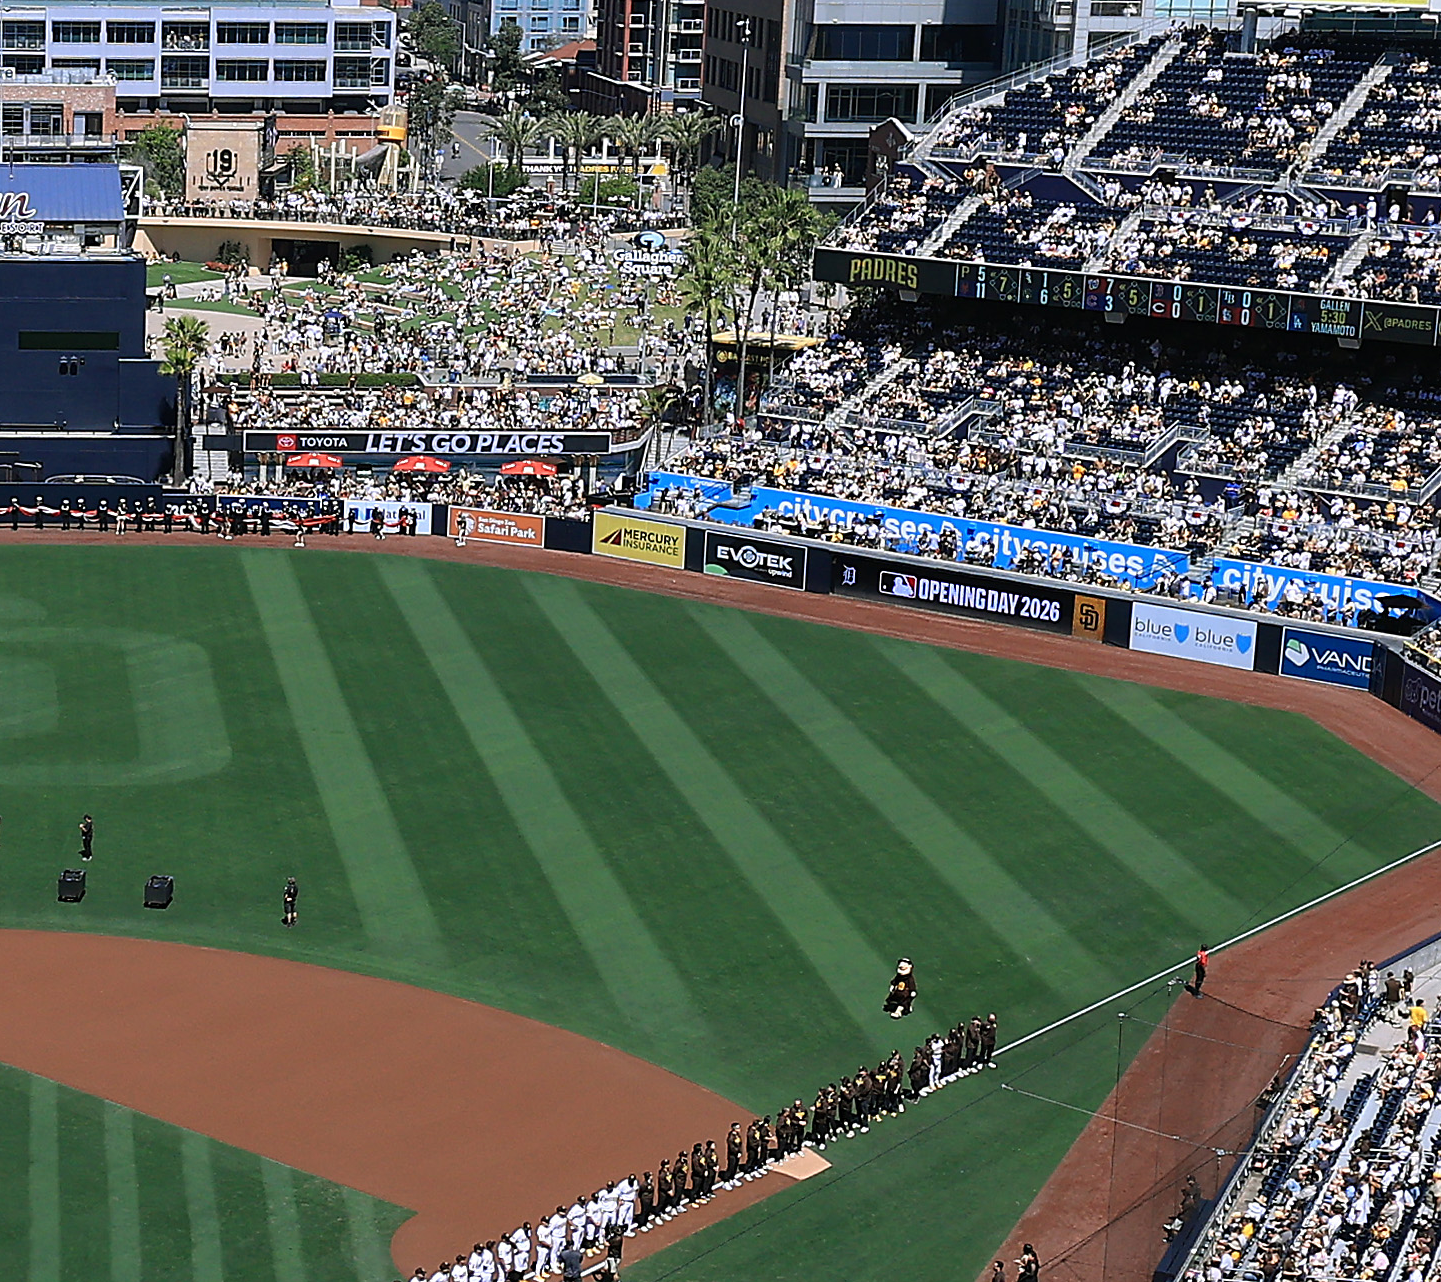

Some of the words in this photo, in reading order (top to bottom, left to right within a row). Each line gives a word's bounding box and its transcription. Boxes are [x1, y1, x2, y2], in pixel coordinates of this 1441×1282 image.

[212, 149, 233, 173] 19
[521, 165, 551, 173] THANK
[614, 248, 683, 267] Gallagher
[623, 263, 672, 277] Square
[849, 258, 918, 289] PADRES
[978, 266, 986, 281] 5
[976, 282, 986, 298] 11
[999, 276, 1008, 292] 7
[1063, 282, 1072, 298] 5
[1106, 279, 1115, 293] 7
[1040, 289, 1049, 304] 6
[1128, 289, 1138, 305] 5
[1173, 285, 1182, 301] 0
[1242, 292, 1252, 308] 0
[1105, 295, 1113, 311] 3
[1172, 302, 1181, 319] 0
[1320, 299, 1351, 312] GALLEN
[1240, 309, 1250, 326] 0
[1321, 311, 1346, 324] 5:30
[1383, 317, 1432, 331] @PADRES
[1311, 322, 1356, 337] YAMAMOTO
[300, 437, 348, 448] TOYOTA
[365, 434, 426, 453] LET'S
[431, 434, 471, 453] GO
[476, 434, 565, 454] PLACES
[478, 522, 509, 536] Safari
[510, 525, 535, 539] Park
[623, 528, 679, 546] MERCURY
[623, 539, 679, 557] INSURANCE
[717, 545, 793, 571] EVOTEK
[918, 578, 986, 611] OPENING
[987, 591, 1020, 615] DAY
[1020, 596, 1061, 622] 2026
[1079, 602, 1098, 631] SD
[1135, 616, 1172, 637] blue
[1195, 627, 1235, 648] blue
